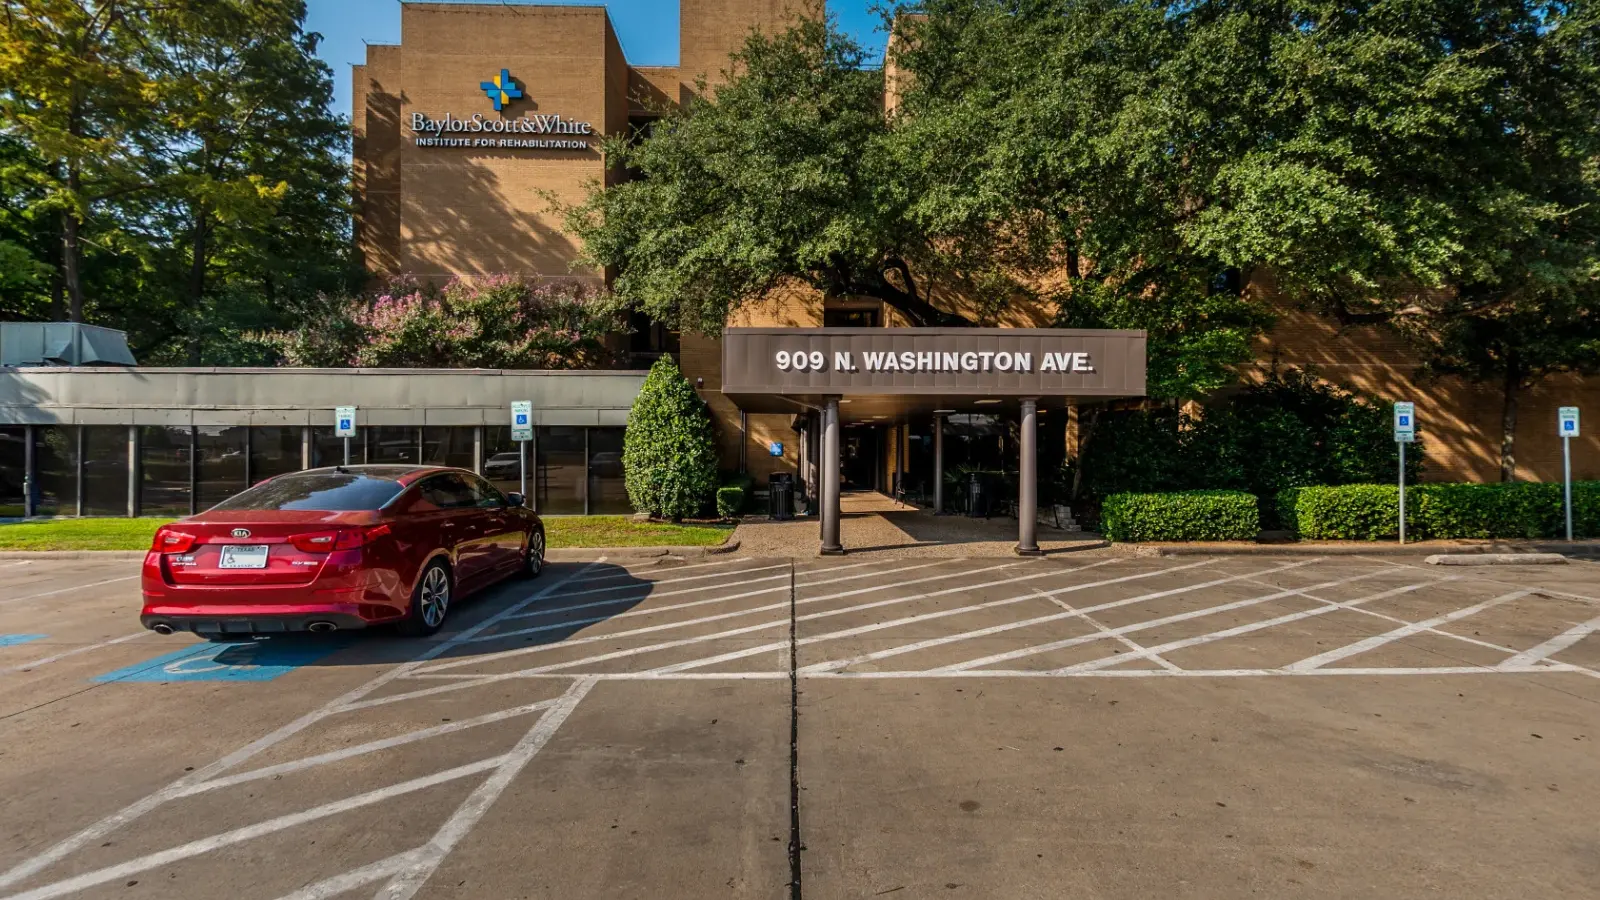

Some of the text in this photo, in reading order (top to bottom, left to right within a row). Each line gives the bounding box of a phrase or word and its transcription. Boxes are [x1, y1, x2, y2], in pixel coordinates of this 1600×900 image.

[415, 138, 587, 149] INSTITUTE FOR REHABILITATION
[775, 350, 1094, 371] 909 N. WASHINGTON AVE.
[233, 530, 248, 538] KIA
